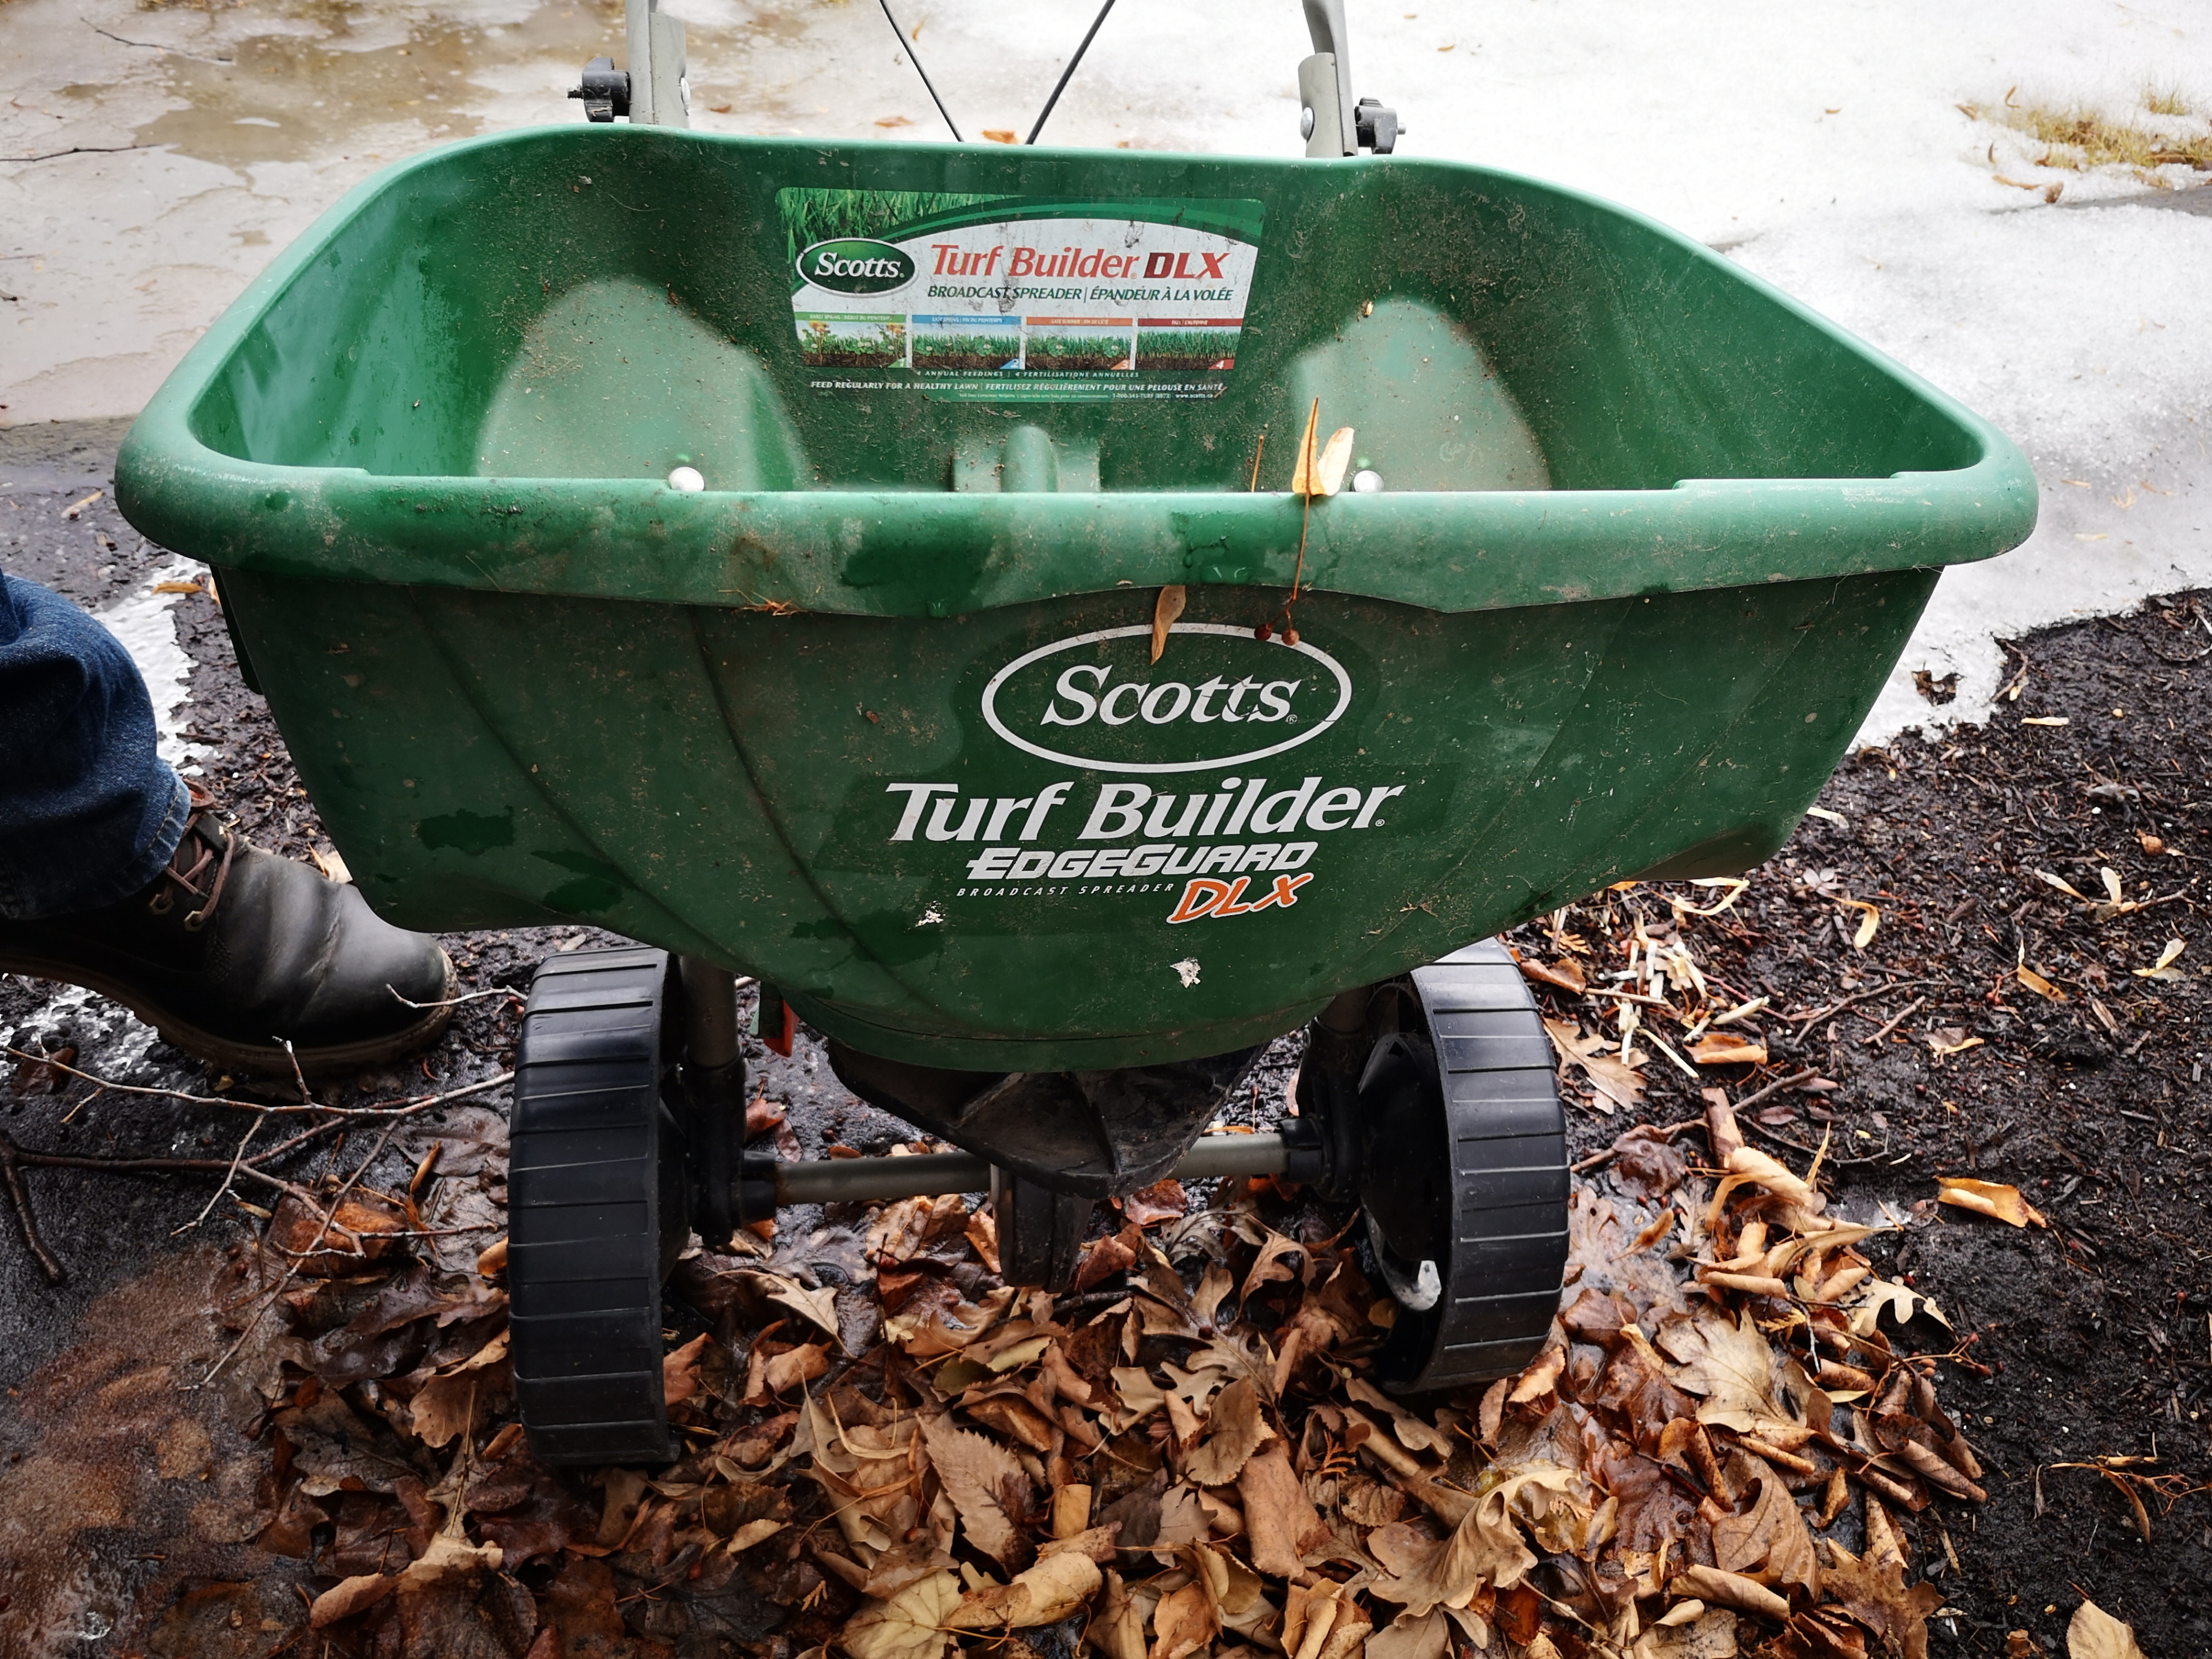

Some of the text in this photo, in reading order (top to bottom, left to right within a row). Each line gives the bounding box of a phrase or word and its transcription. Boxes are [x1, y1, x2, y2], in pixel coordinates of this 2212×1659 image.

[814, 251, 901, 279] Scotts
[931, 244, 1231, 279] Turf Builder DLX
[927, 285, 1234, 301] BROADCAST SPREADER ÉPANDEUR À LA VOLÉE
[899, 358, 905, 367] 1
[1010, 359, 1019, 368] 2
[1121, 360, 1129, 369] 3
[1215, 360, 1225, 369] 4
[1034, 382, 1102, 391] RÉGULIÈREMENT
[1197, 383, 1224, 391] SANTÉ
[1040, 664, 1302, 726] Scotts
[885, 776, 1406, 841] Turf Builder
[966, 842, 1318, 880] EDGEGUARD
[956, 883, 1174, 897] BROADCAST SPREADER
[1166, 872, 1314, 924] DLX
